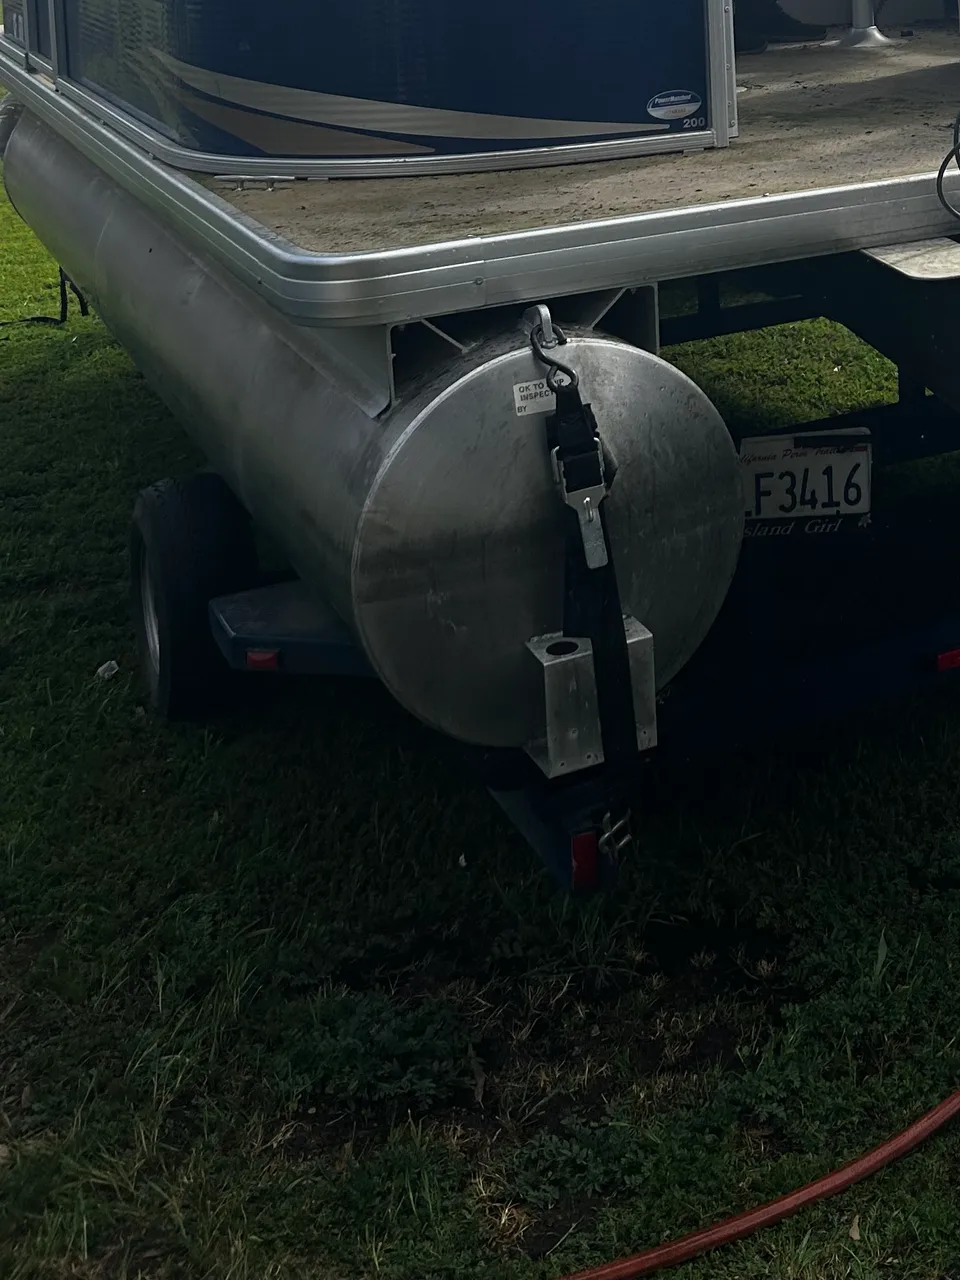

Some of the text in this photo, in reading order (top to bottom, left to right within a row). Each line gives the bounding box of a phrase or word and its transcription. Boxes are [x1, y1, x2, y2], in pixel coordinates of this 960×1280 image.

[683, 117, 705, 129] 200
[519, 385, 530, 393] OK
[533, 382, 544, 390] TO
[517, 405, 528, 413] BY
[745, 462, 861, 517] F3416
[804, 517, 843, 534] Girl
